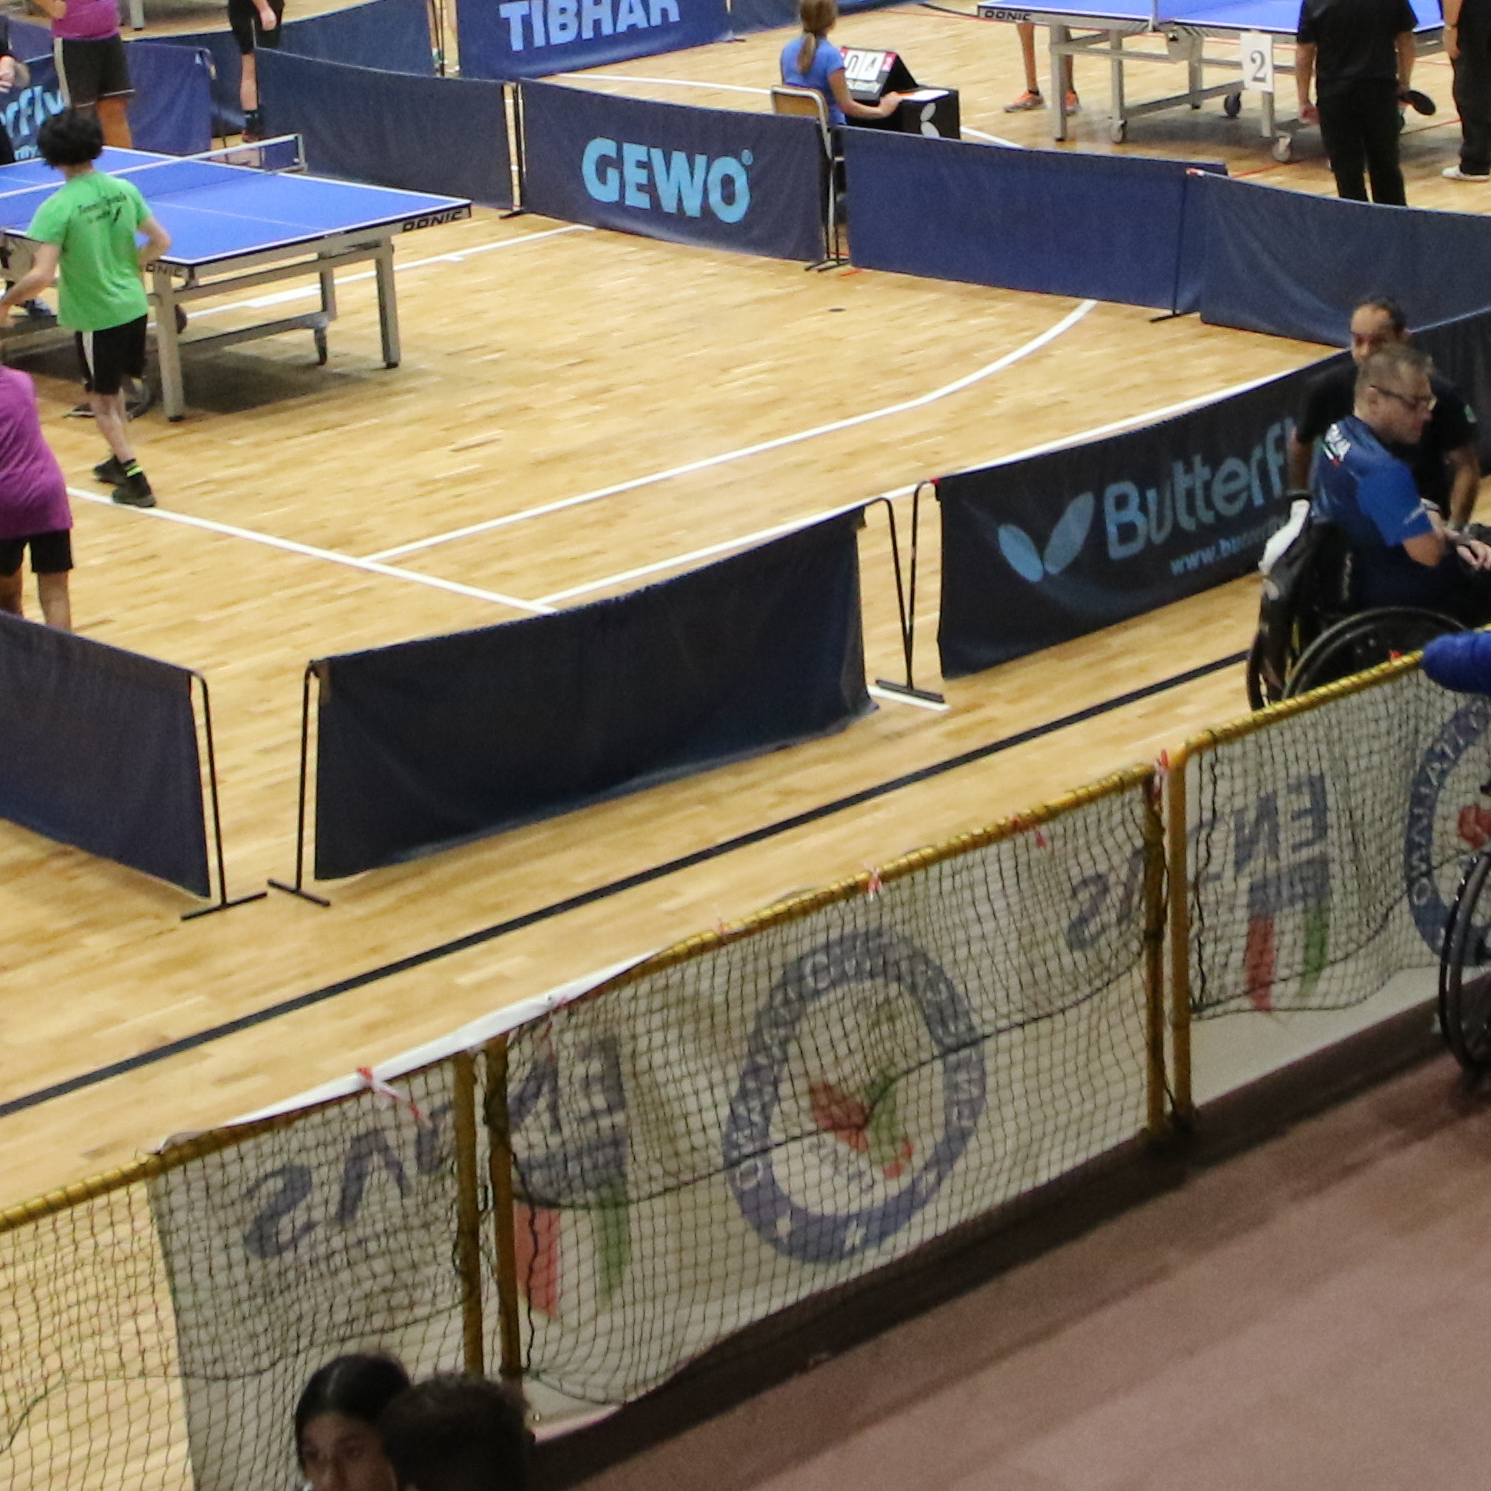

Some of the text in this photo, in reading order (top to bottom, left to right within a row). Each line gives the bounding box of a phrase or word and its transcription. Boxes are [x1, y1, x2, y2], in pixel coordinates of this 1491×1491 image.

[984, 9, 1031, 22] DONIC
[1250, 50, 1267, 83] 2
[580, 136, 751, 225] GEWO
[403, 210, 464, 232] DONIC
[143, 261, 186, 279] ONIC
